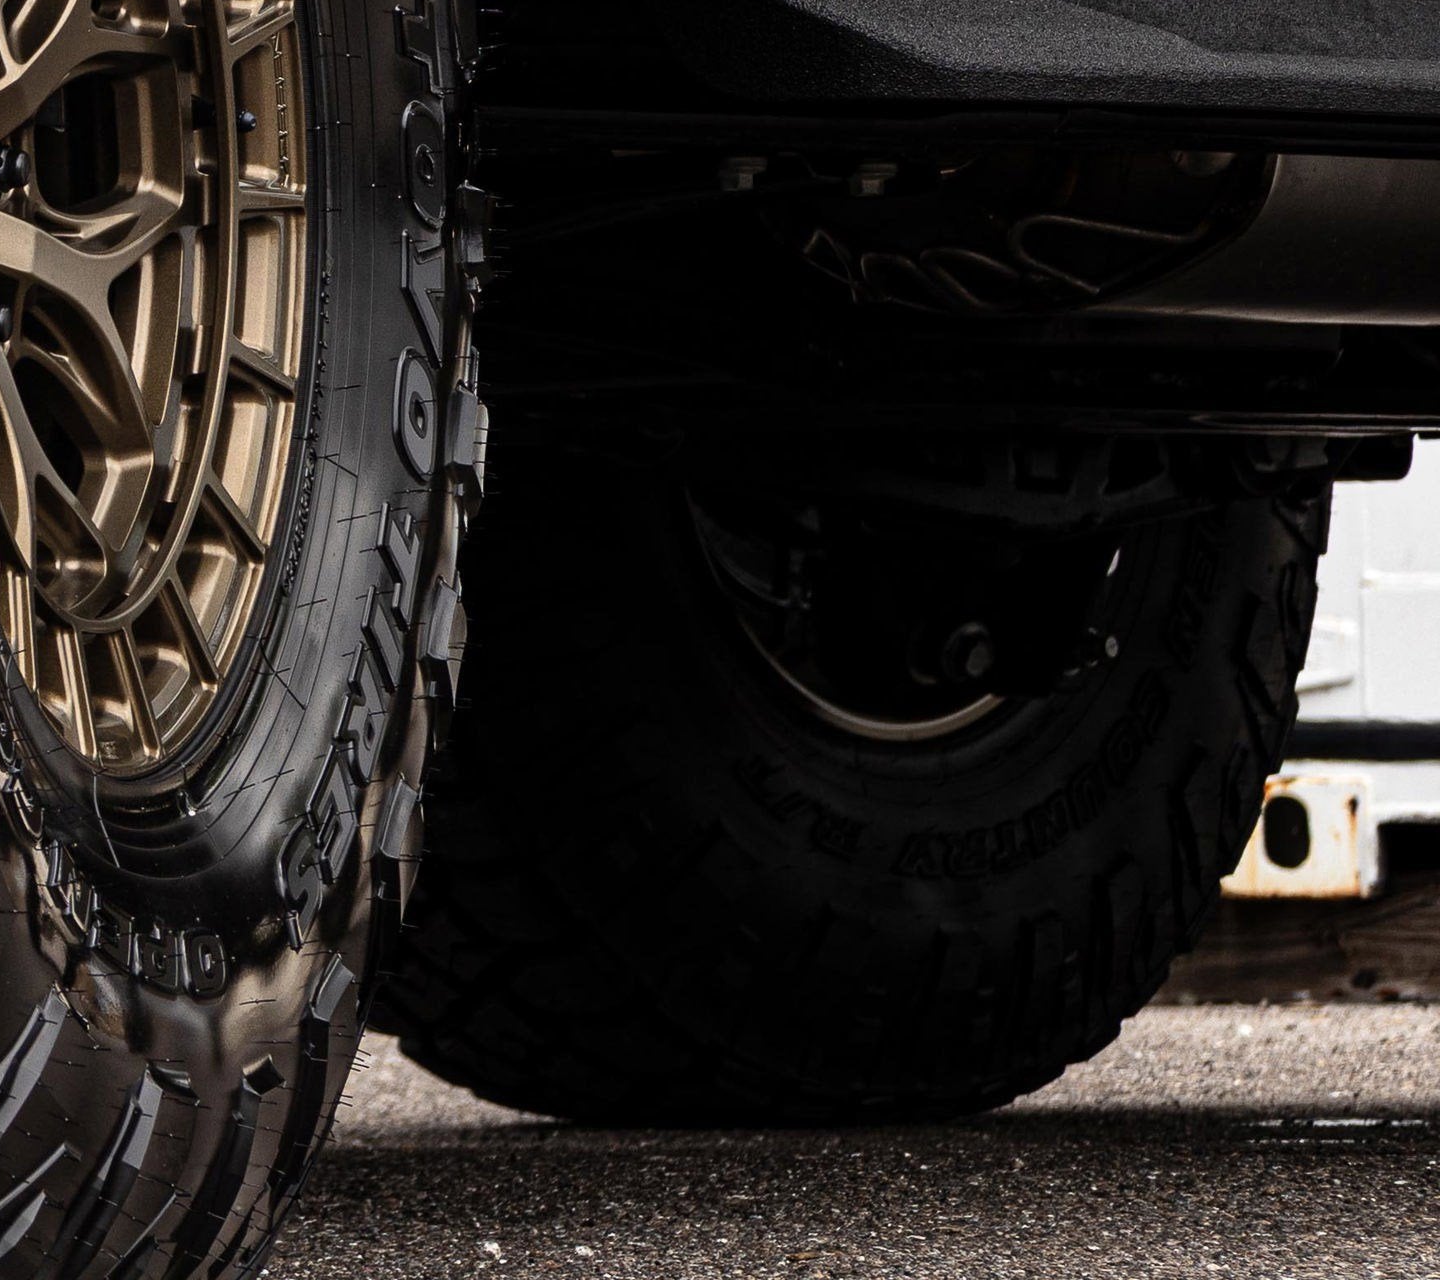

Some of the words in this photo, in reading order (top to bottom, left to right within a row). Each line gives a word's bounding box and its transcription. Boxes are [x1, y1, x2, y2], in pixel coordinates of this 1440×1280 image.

[277, 500, 422, 951] TIRES
[892, 669, 1171, 879] COUNTRY
[46, 841, 228, 1002] OPEN
